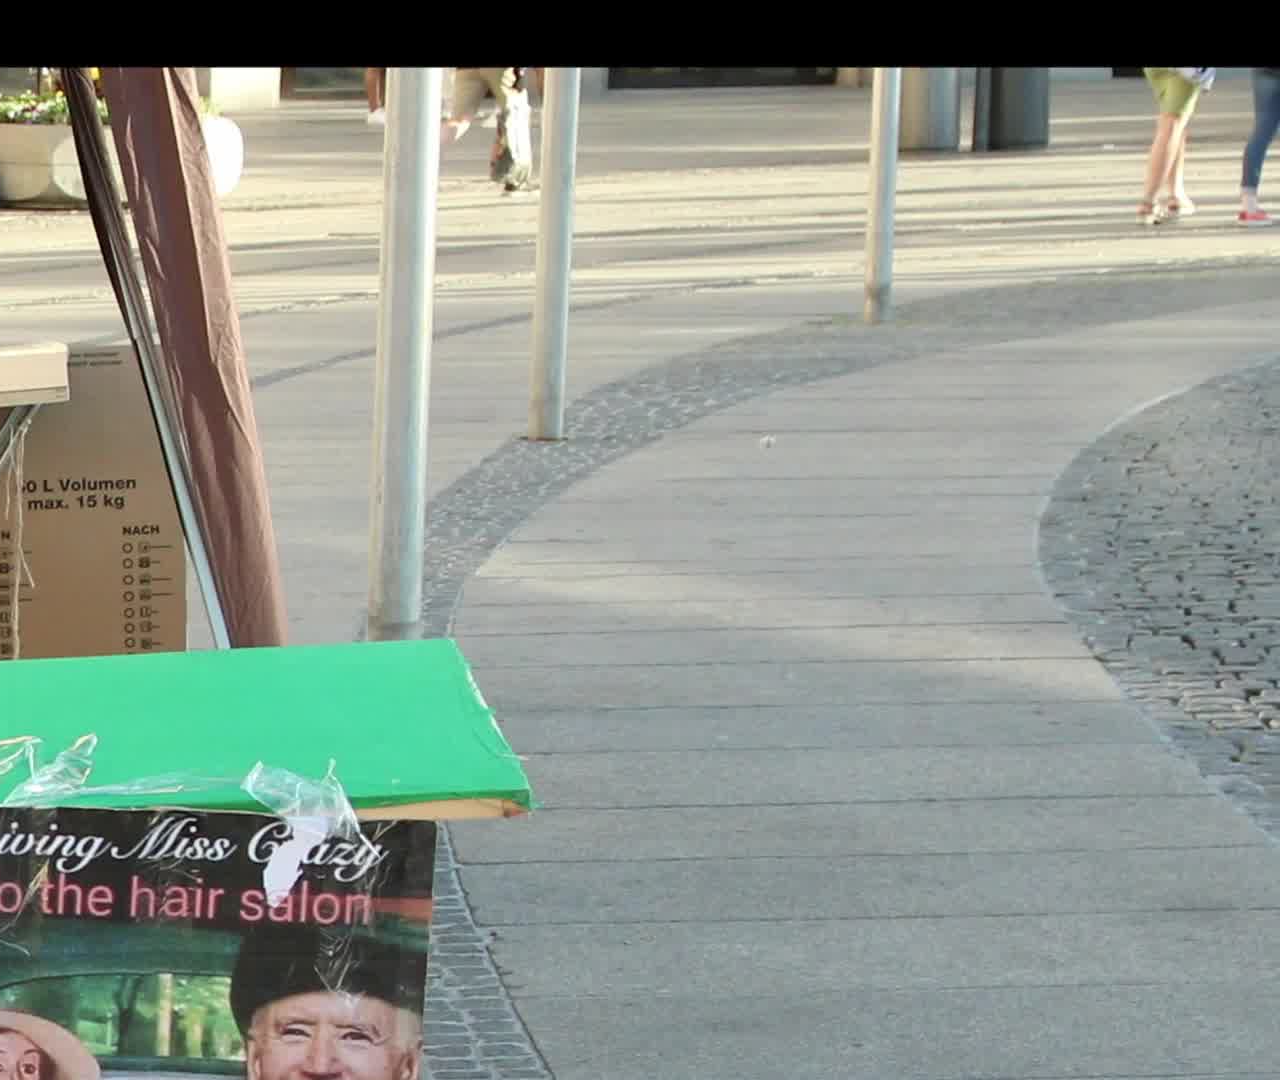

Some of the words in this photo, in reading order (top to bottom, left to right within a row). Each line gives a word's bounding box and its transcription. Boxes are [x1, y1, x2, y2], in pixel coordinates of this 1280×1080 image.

[43, 480, 53, 492] L
[59, 478, 137, 492] Volumen
[28, 498, 69, 511] max.
[77, 495, 97, 508] 15
[104, 495, 125, 509] kg
[122, 525, 160, 536] NACH
[111, 816, 238, 861] Miss
[248, 821, 390, 882] Cazy
[41, 873, 113, 917] the
[130, 875, 225, 921] hair
[240, 880, 371, 925] salon
